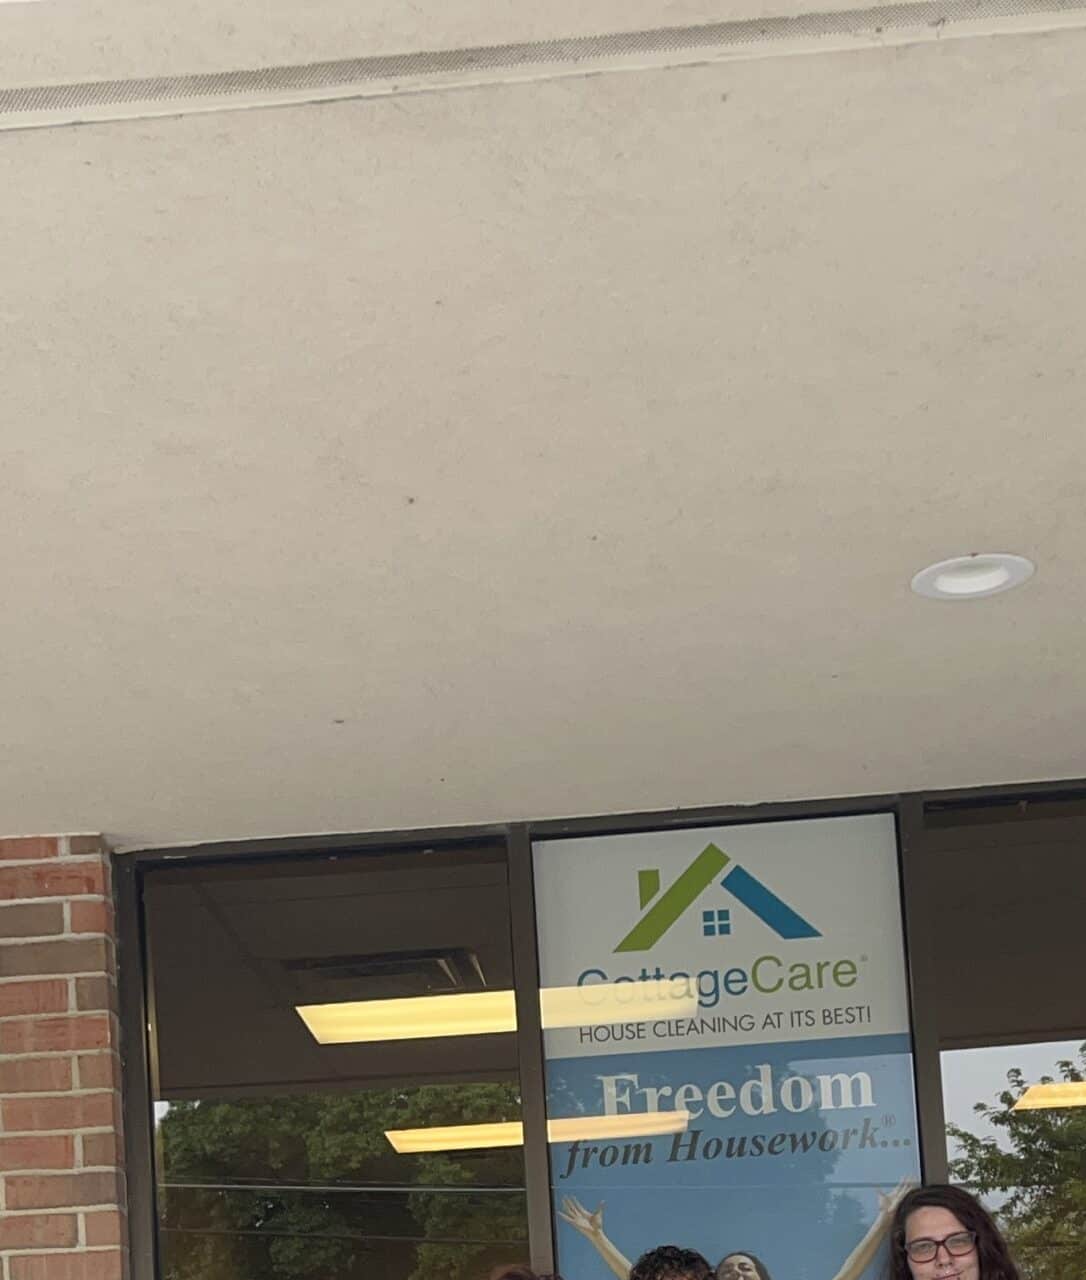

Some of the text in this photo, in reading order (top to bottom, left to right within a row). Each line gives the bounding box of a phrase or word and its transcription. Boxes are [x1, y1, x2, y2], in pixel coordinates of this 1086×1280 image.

[579, 1006, 872, 1043] HOUSE CLEANING AT ITS BEST!
[600, 1063, 877, 1121] Freedom
[560, 1137, 654, 1178] from
